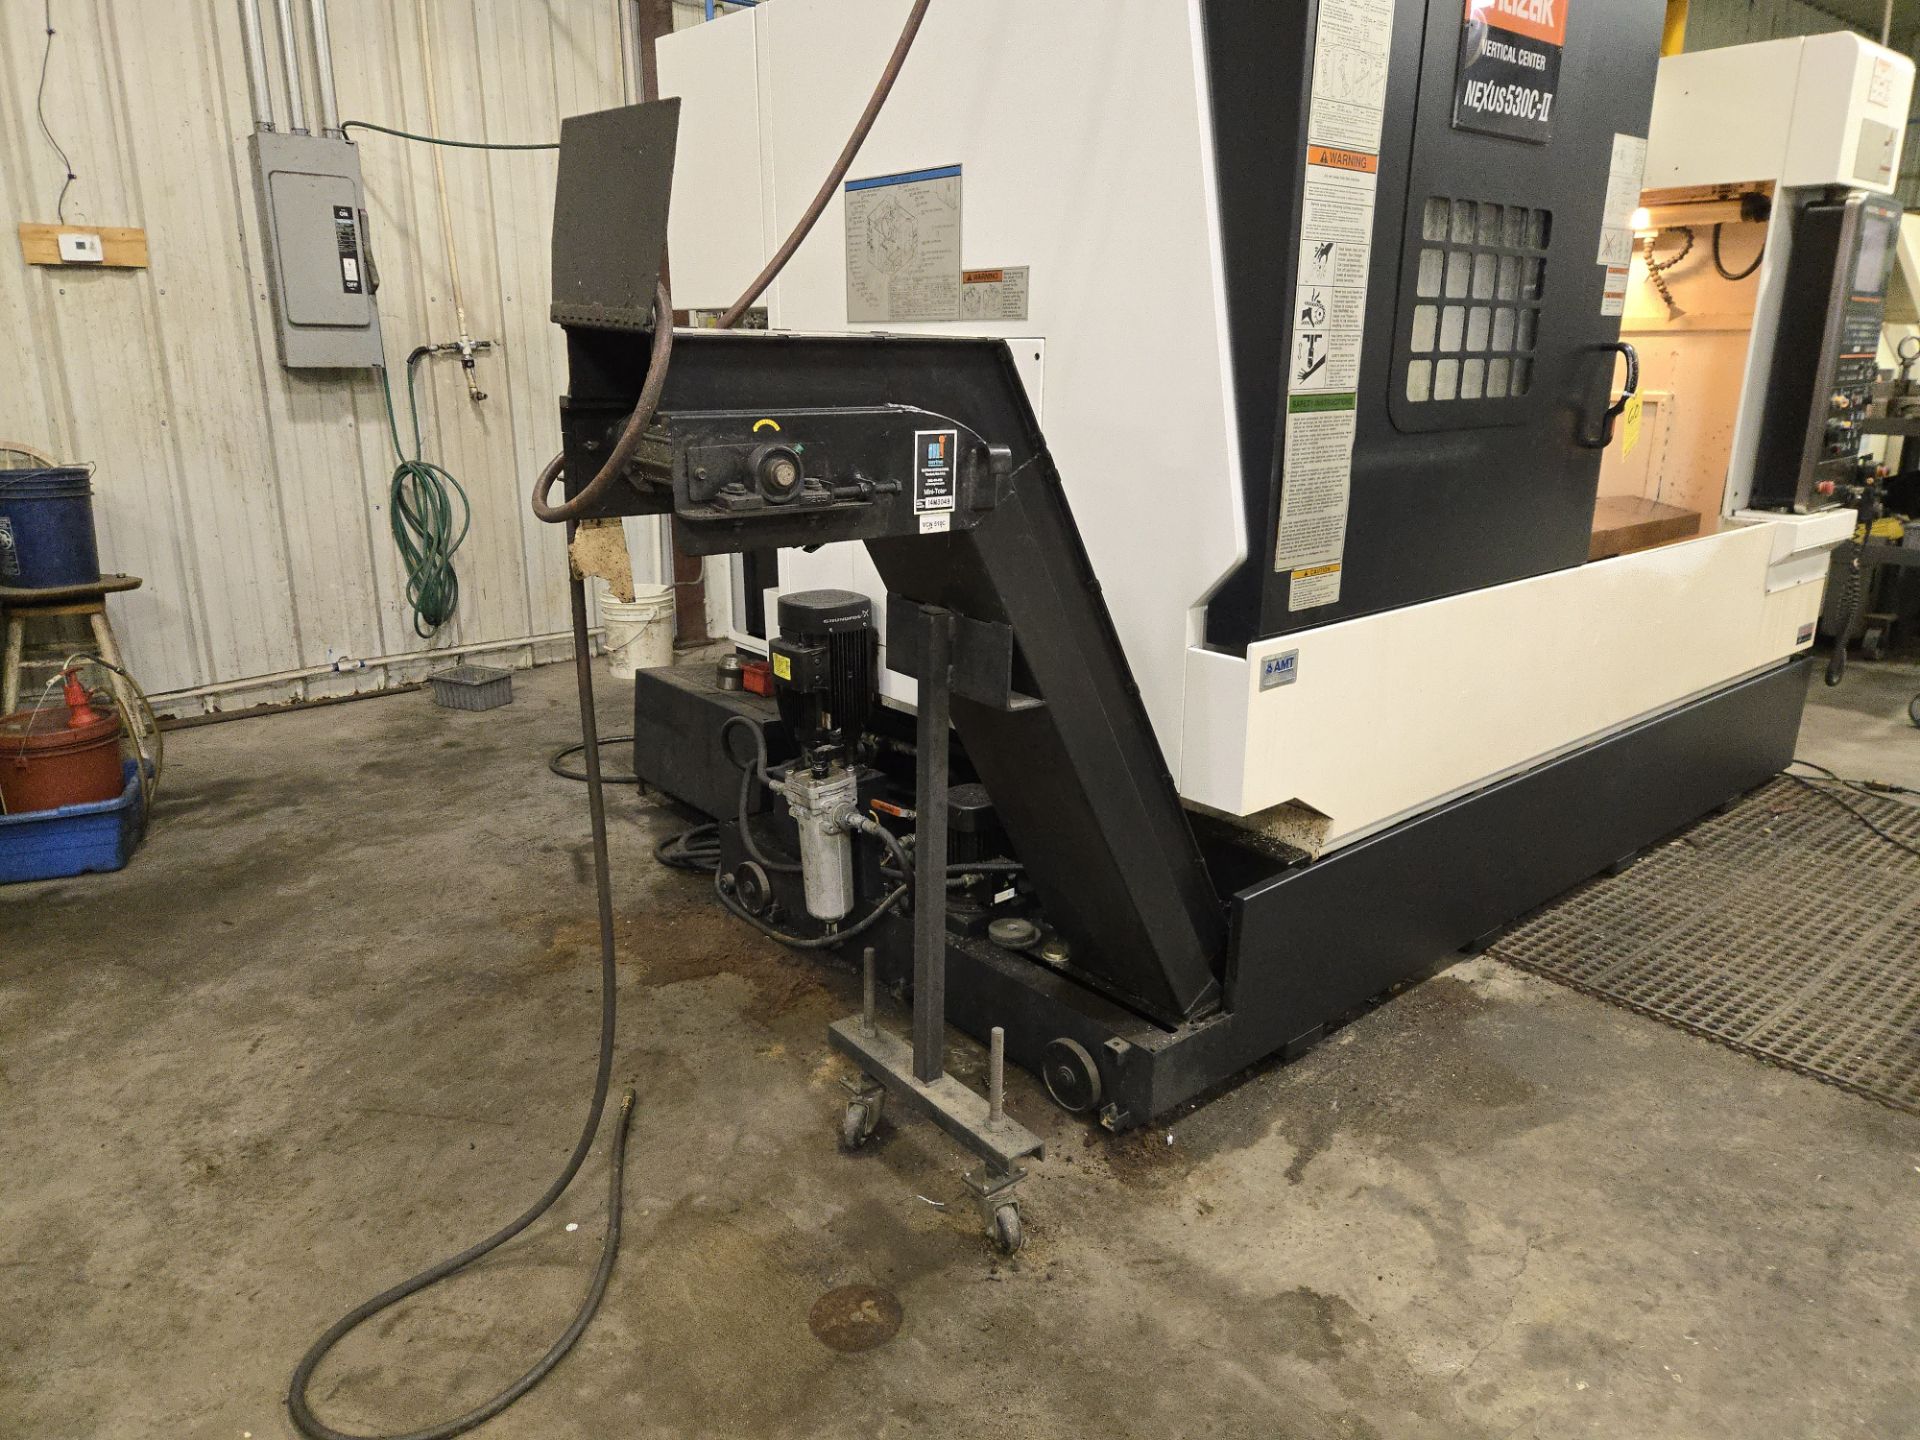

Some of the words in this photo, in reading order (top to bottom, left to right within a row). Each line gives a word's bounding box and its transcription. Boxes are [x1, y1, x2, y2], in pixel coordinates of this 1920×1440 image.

[1481, 38, 1517, 64] VERTICAL
[1518, 48, 1547, 71] CENTER
[1329, 151, 1367, 169] WARNING
[1309, 566, 1331, 575] CAUTION
[1273, 656, 1295, 672] AMT
